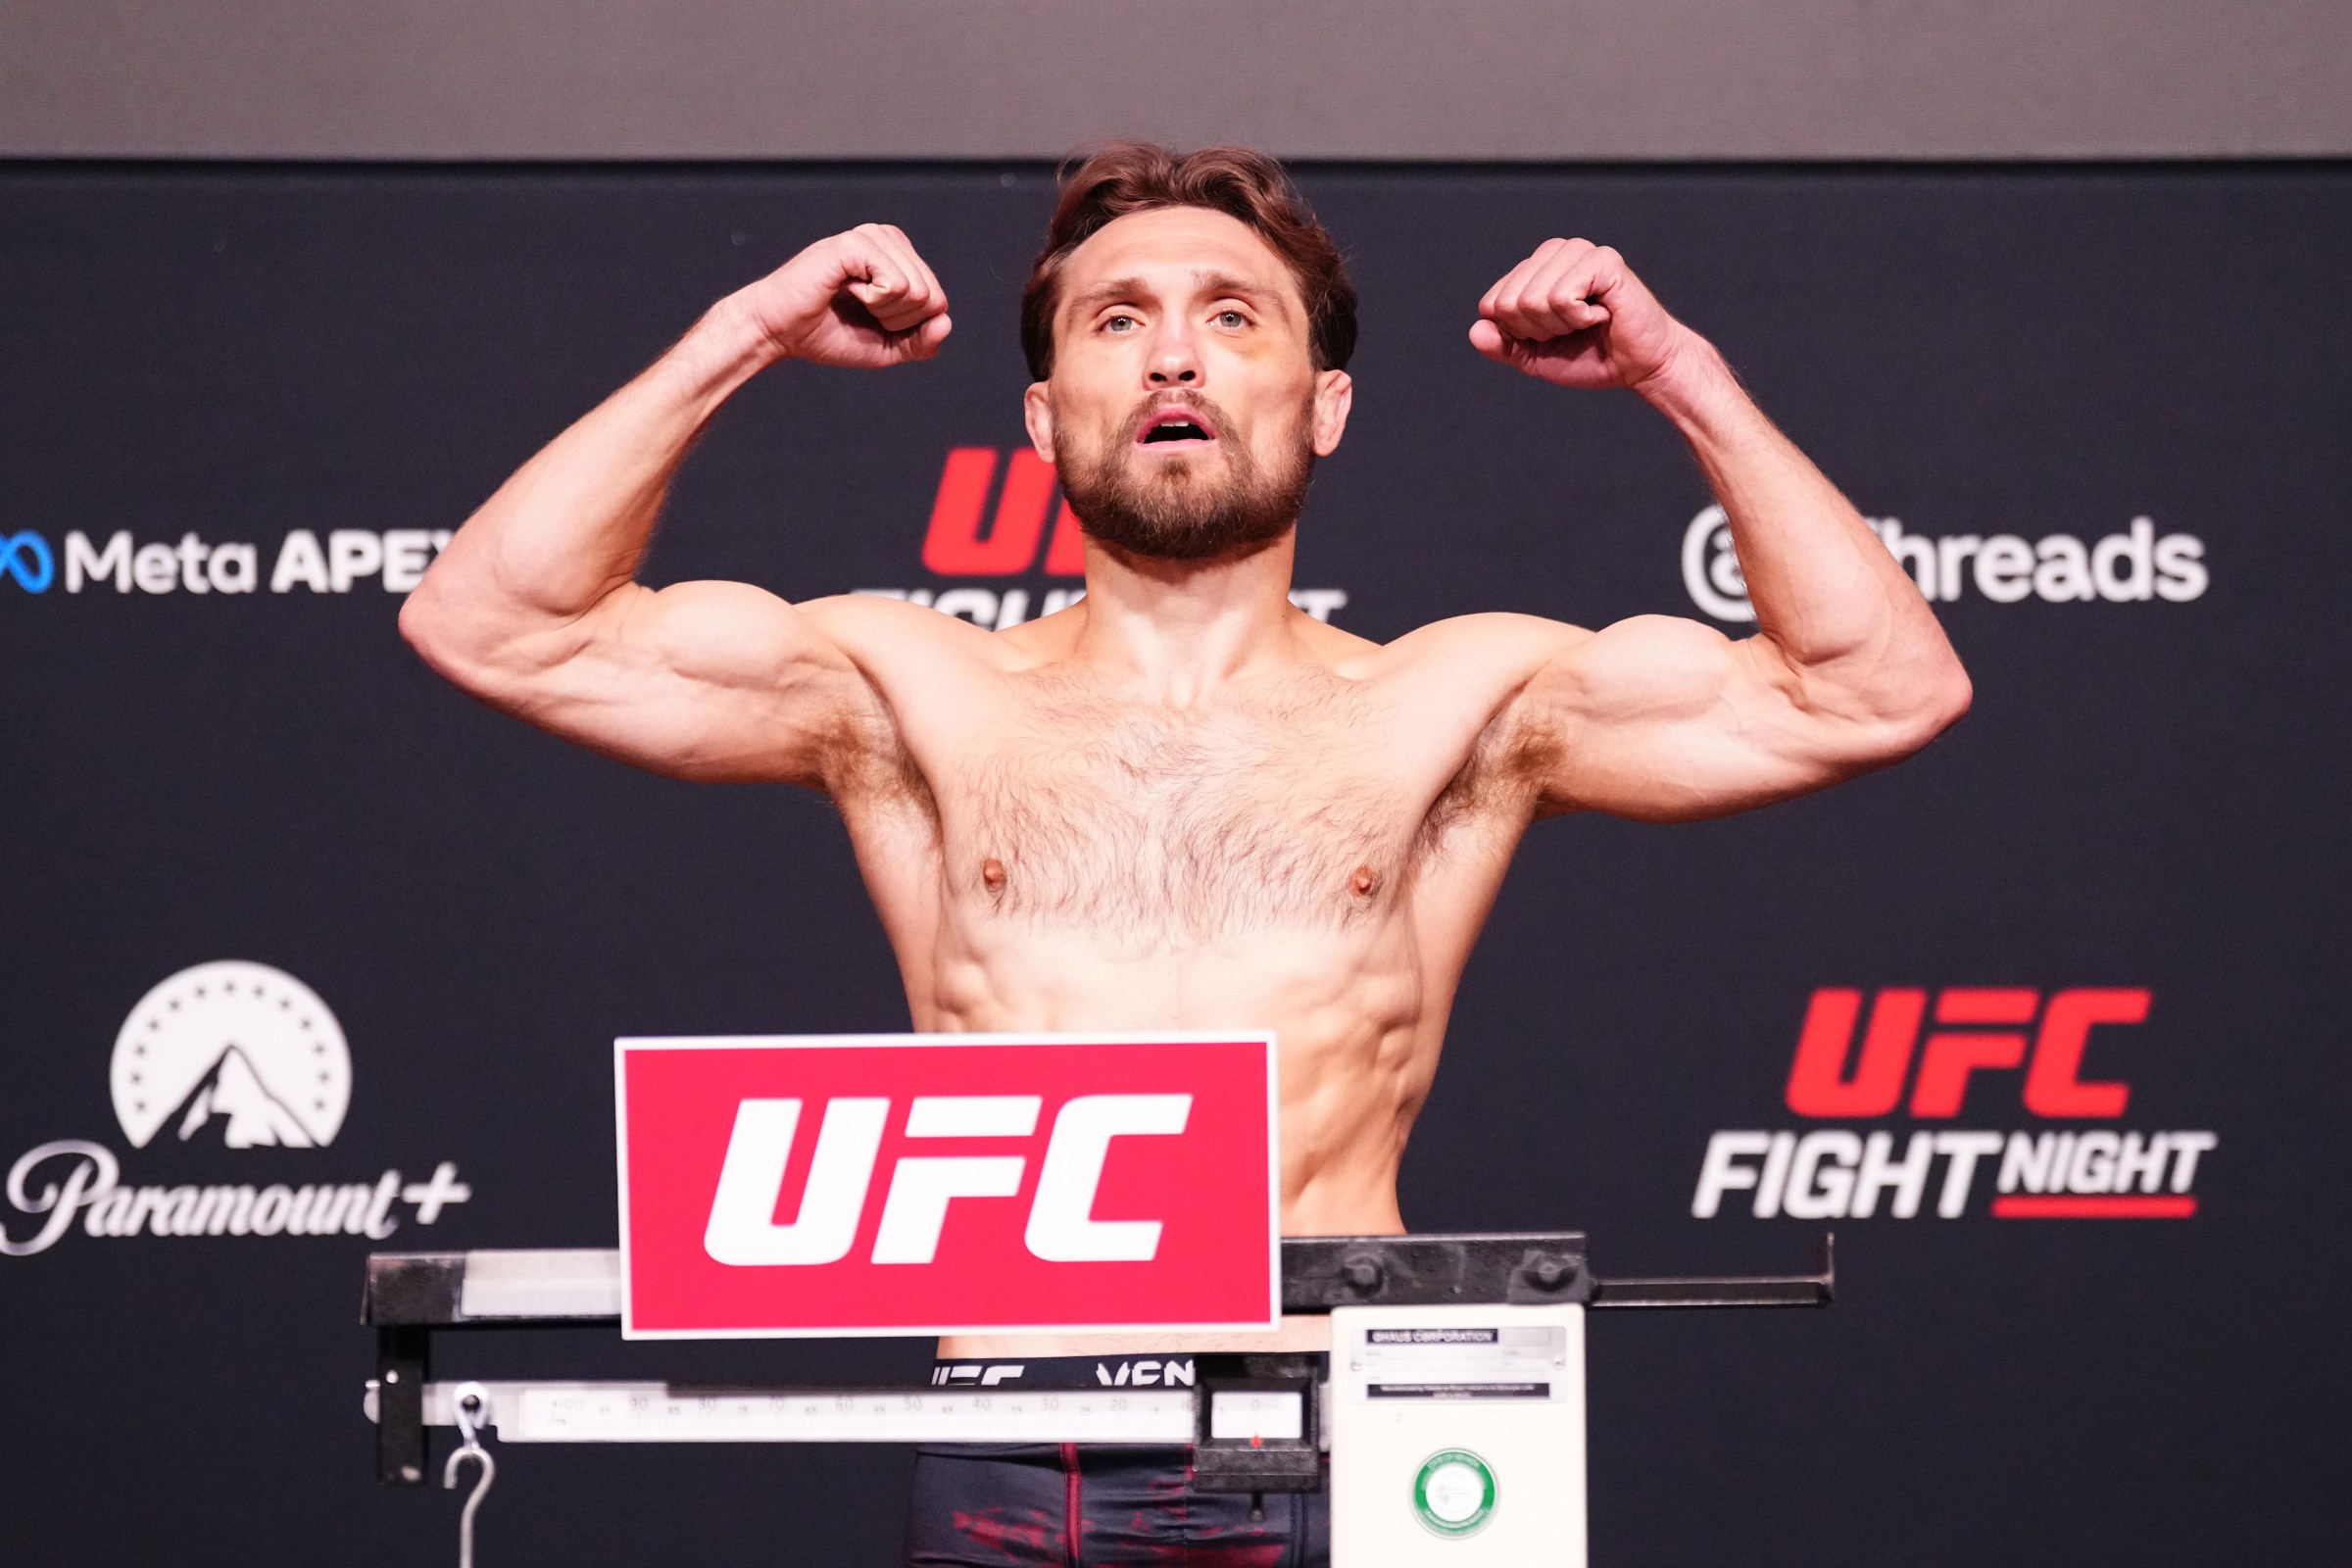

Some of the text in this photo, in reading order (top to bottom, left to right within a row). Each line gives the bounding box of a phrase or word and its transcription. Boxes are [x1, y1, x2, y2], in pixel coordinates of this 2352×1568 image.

[66, 529, 454, 594] Meta APE
[1864, 515, 2209, 602] hreads
[1786, 989, 2151, 1117] UFC
[0, 1140, 470, 1255] Paramount+
[704, 1094, 1194, 1266] UFC
[1691, 1131, 2217, 1218] FIGHT NIGHT
[1096, 1359, 1195, 1386] VEN
